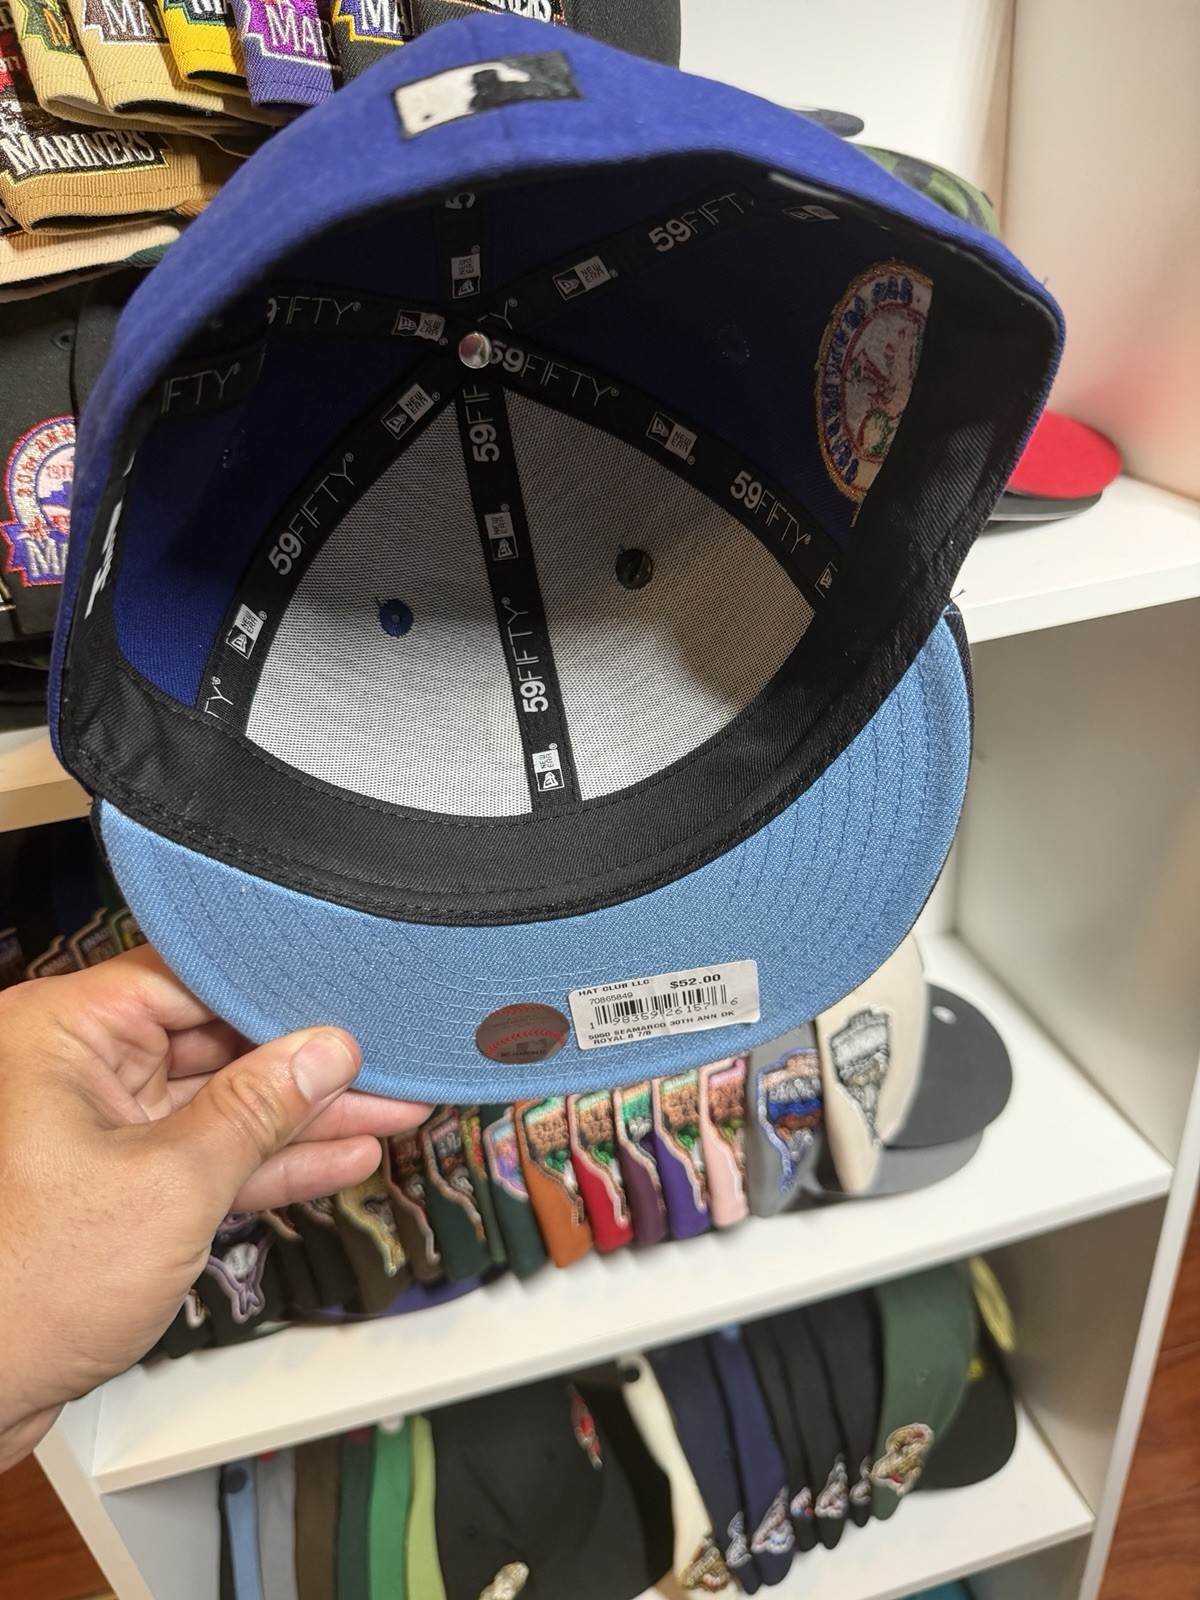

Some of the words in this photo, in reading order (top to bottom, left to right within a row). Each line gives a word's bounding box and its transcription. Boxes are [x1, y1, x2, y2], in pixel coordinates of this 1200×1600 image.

[0, 130, 155, 175] MARINERS
[578, 987, 598, 997] HAT
[602, 982, 628, 992] CLUB
[632, 979, 651, 988] LLC
[669, 973, 722, 989] $52.00
[589, 992, 634, 1005] 70865849
[696, 1012, 718, 1022] ANN
[721, 1010, 735, 1018] DK
[593, 1035, 624, 1046] ROYAL
